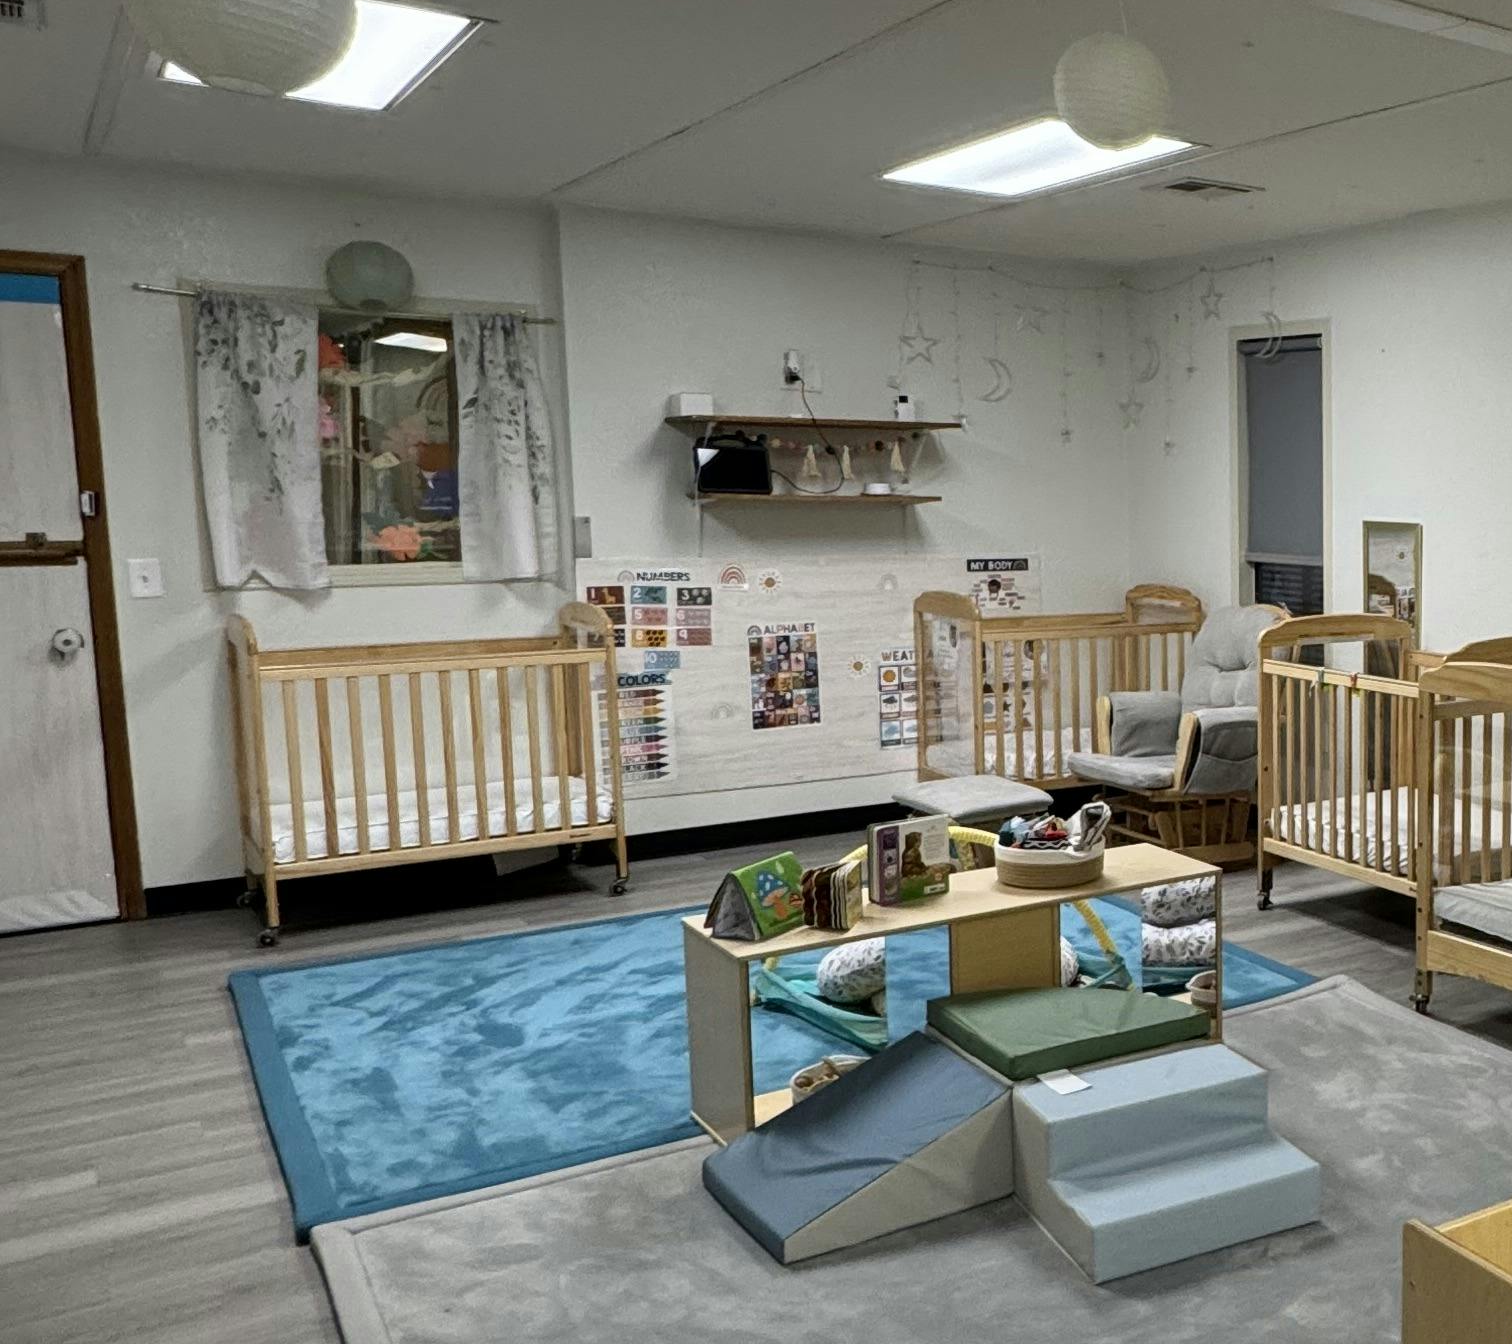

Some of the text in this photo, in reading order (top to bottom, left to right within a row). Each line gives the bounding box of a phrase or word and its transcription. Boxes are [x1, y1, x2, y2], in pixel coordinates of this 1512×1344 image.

[970, 560, 1014, 570] MY BODY
[636, 572, 691, 582] NUMBERS
[590, 587, 690, 601] 1 2 3
[634, 608, 685, 621] 5 6
[764, 623, 815, 634] ALPHABET
[635, 631, 643, 641] 8
[679, 629, 688, 640] 9
[646, 653, 657, 664] 10
[617, 674, 666, 687] COLORS
